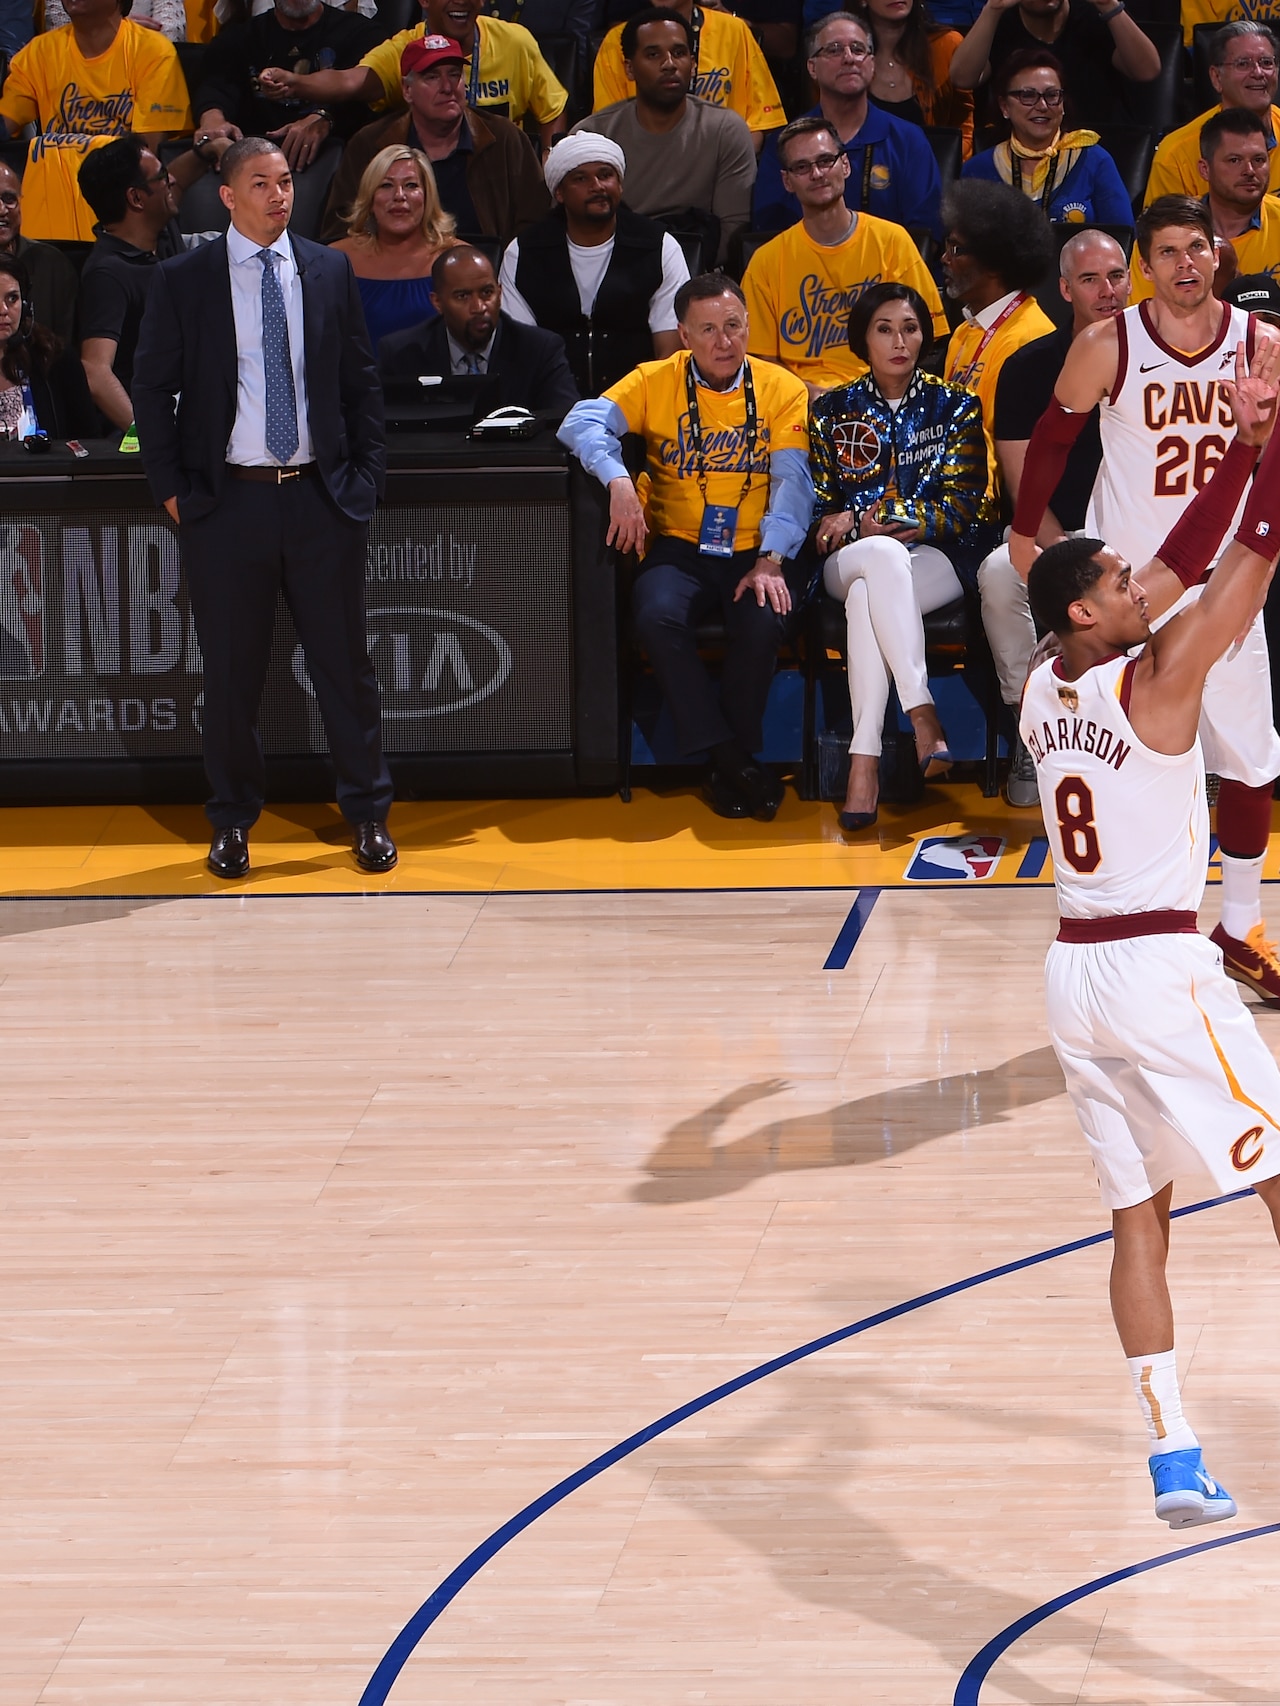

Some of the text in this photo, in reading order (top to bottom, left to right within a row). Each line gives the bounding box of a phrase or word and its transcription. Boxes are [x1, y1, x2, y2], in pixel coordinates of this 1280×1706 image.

[59, 82, 135, 128] Strength
[1143, 381, 1238, 431] CAVS
[908, 424, 944, 446] WORLD
[1154, 434, 1227, 497] 26
[365, 533, 477, 589] sented by
[366, 633, 474, 692] IA
[1028, 717, 1132, 771] CLARKSON
[1055, 774, 1104, 876] 8
